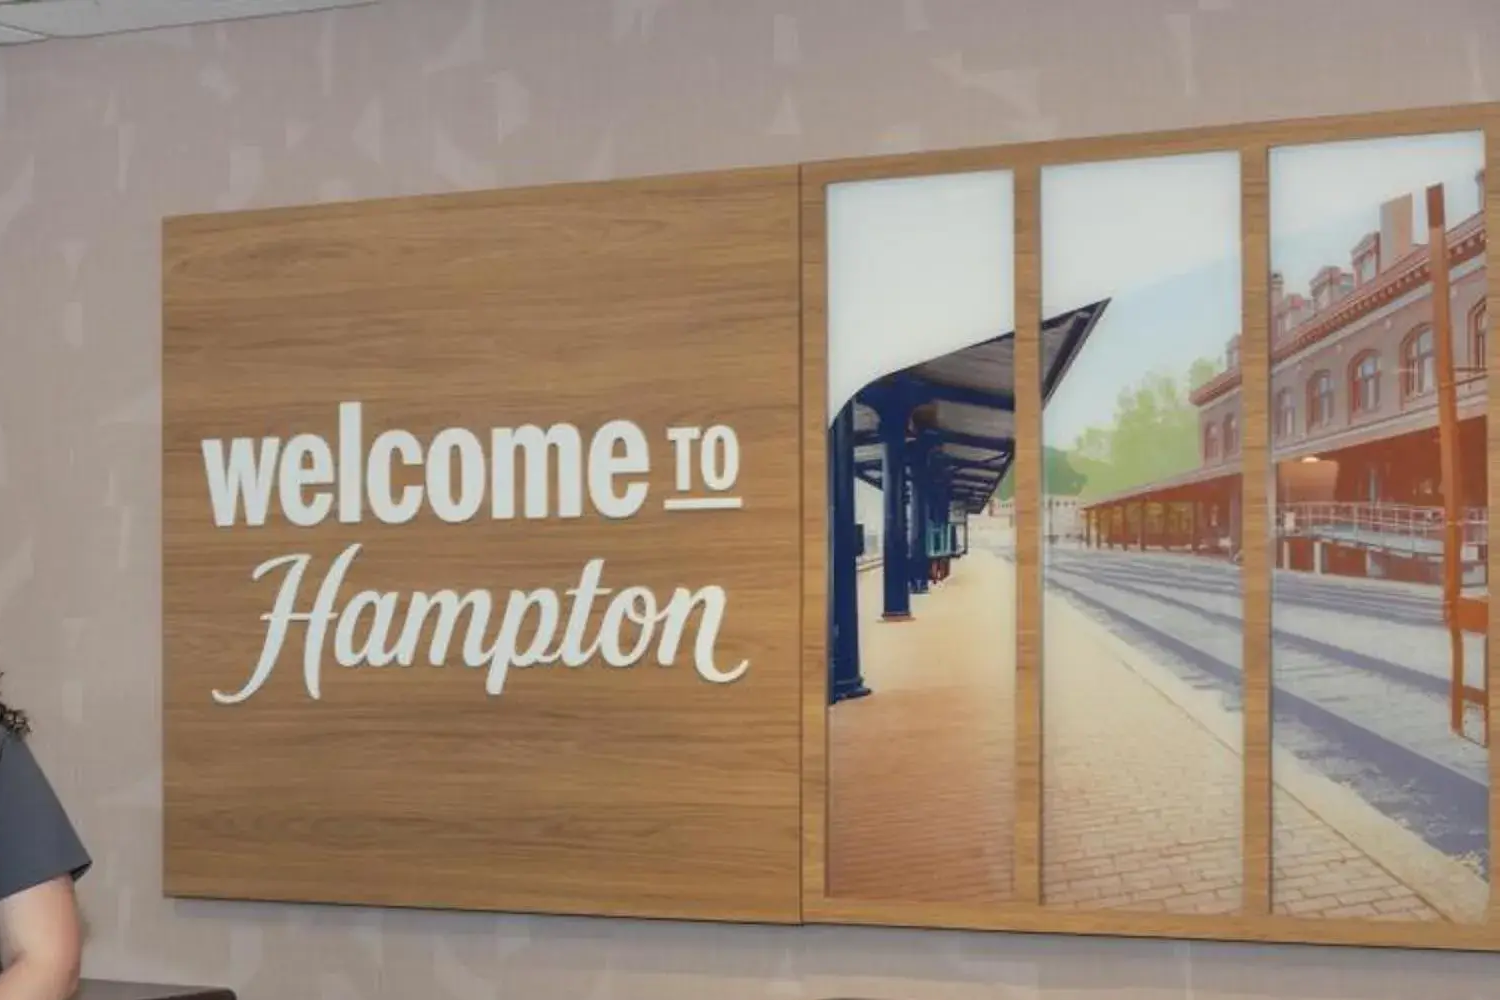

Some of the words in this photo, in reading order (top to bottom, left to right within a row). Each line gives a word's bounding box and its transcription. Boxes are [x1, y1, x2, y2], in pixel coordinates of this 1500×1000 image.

[201, 401, 650, 527] welcome
[666, 423, 740, 492] TO
[211, 543, 749, 704] Hampton
